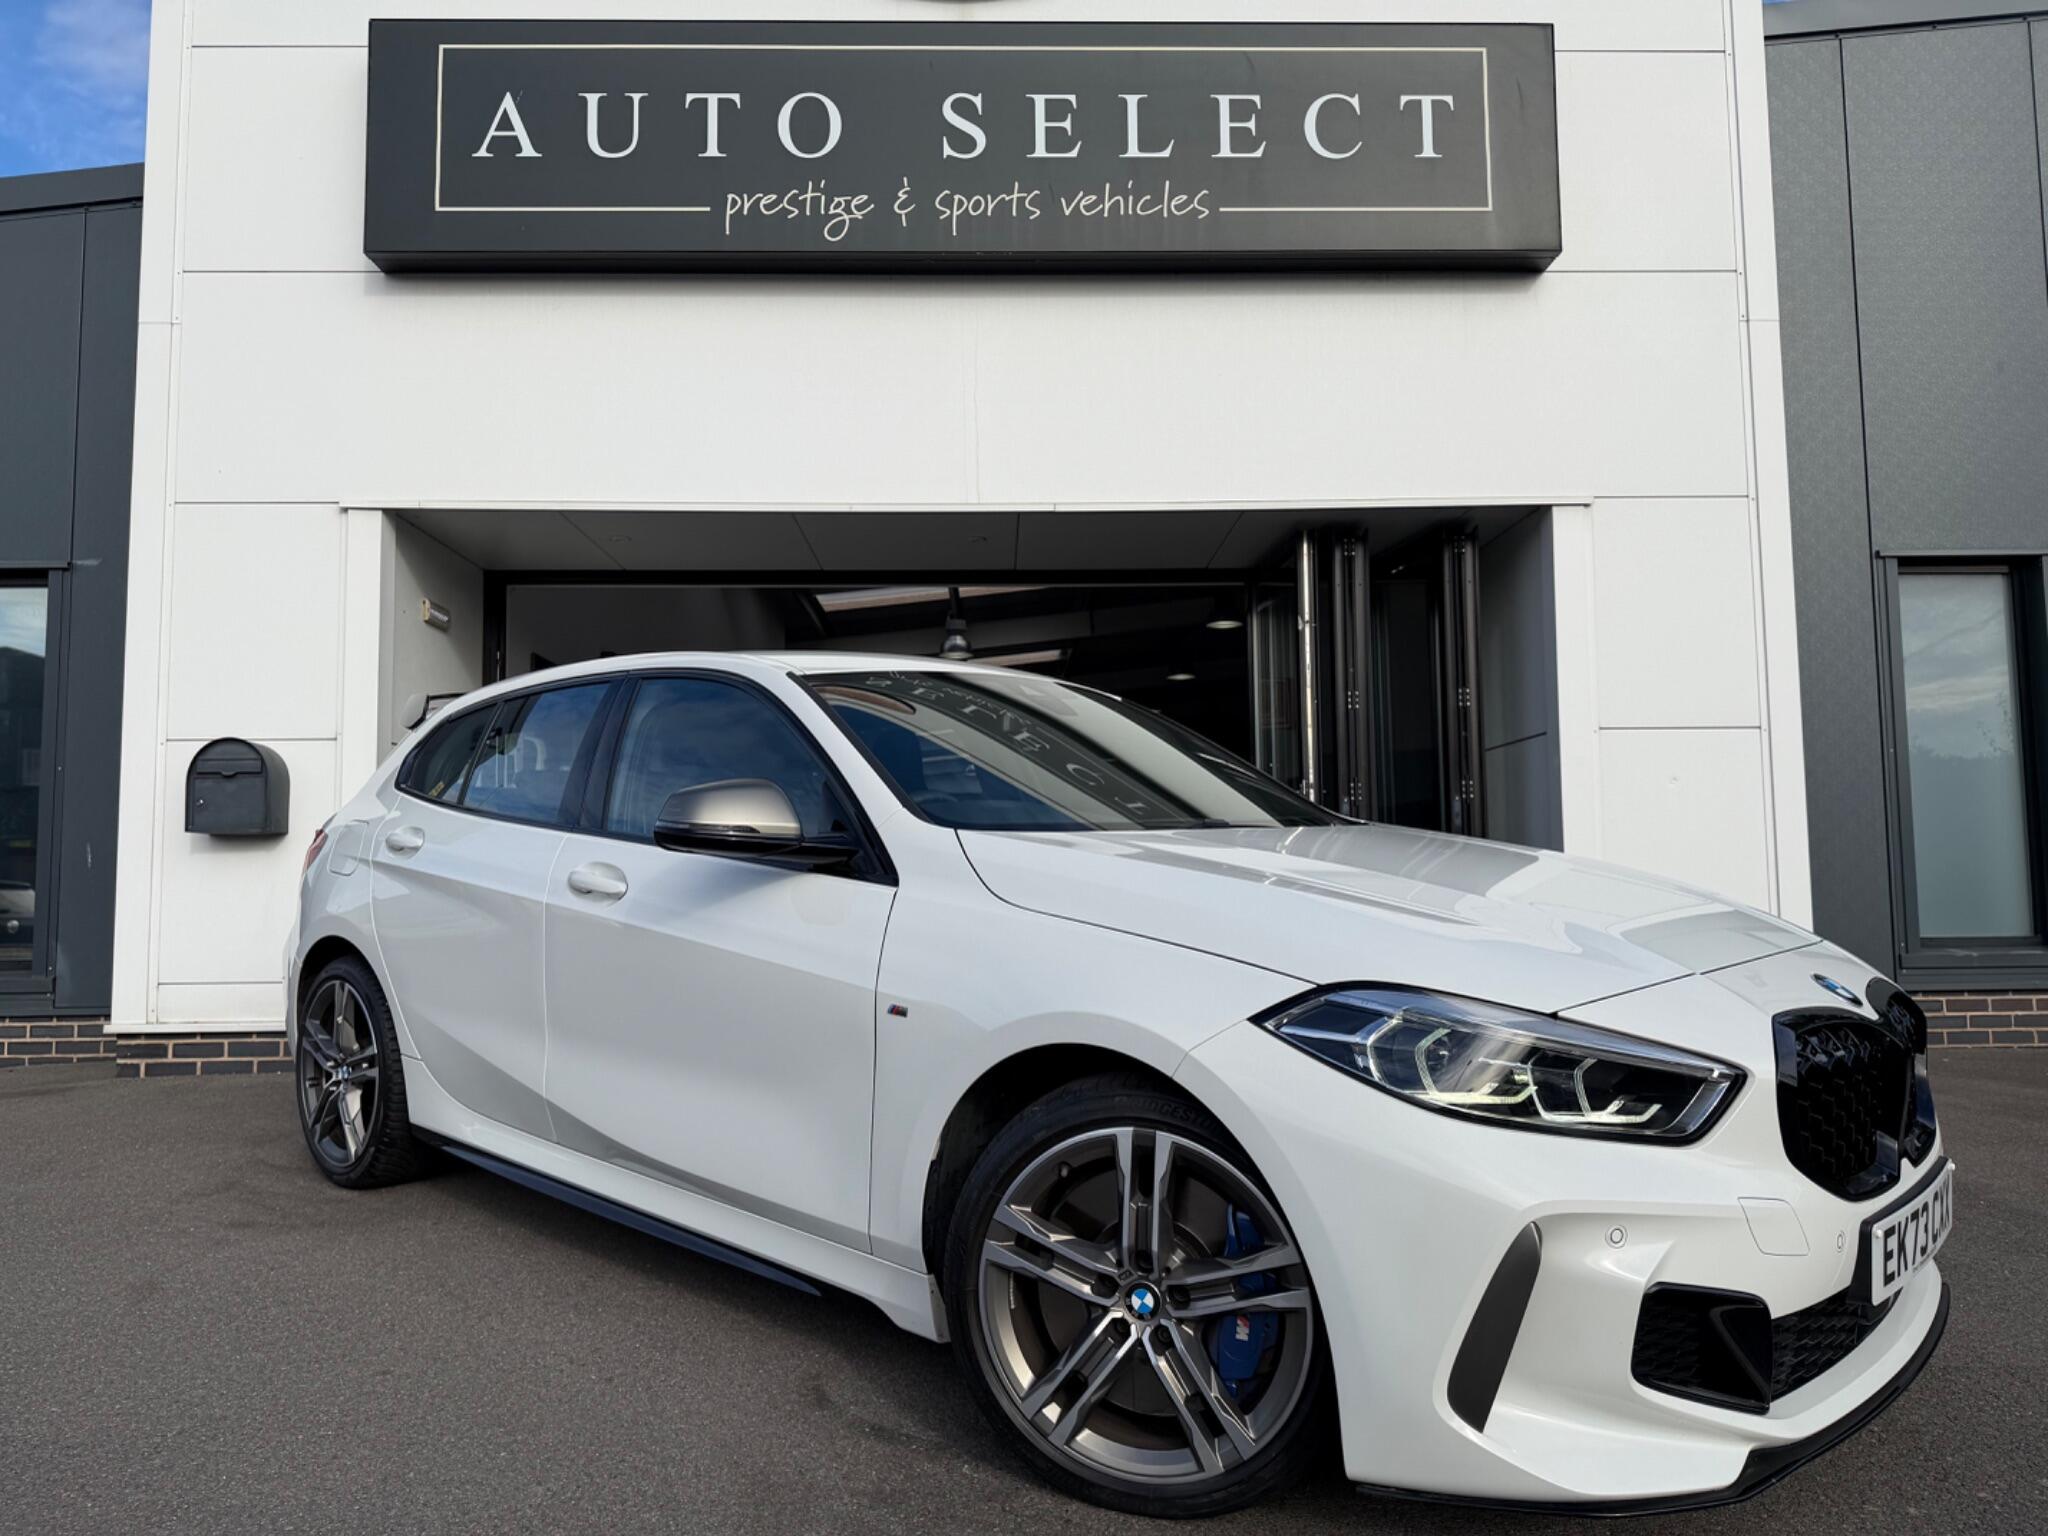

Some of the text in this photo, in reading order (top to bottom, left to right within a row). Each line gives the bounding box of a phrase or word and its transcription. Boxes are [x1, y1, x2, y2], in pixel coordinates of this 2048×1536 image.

[471, 91, 1455, 160] AUTO SELECT
[725, 176, 1210, 242] prestige & sports vehicles
[1883, 1201, 1930, 1287] EK73
